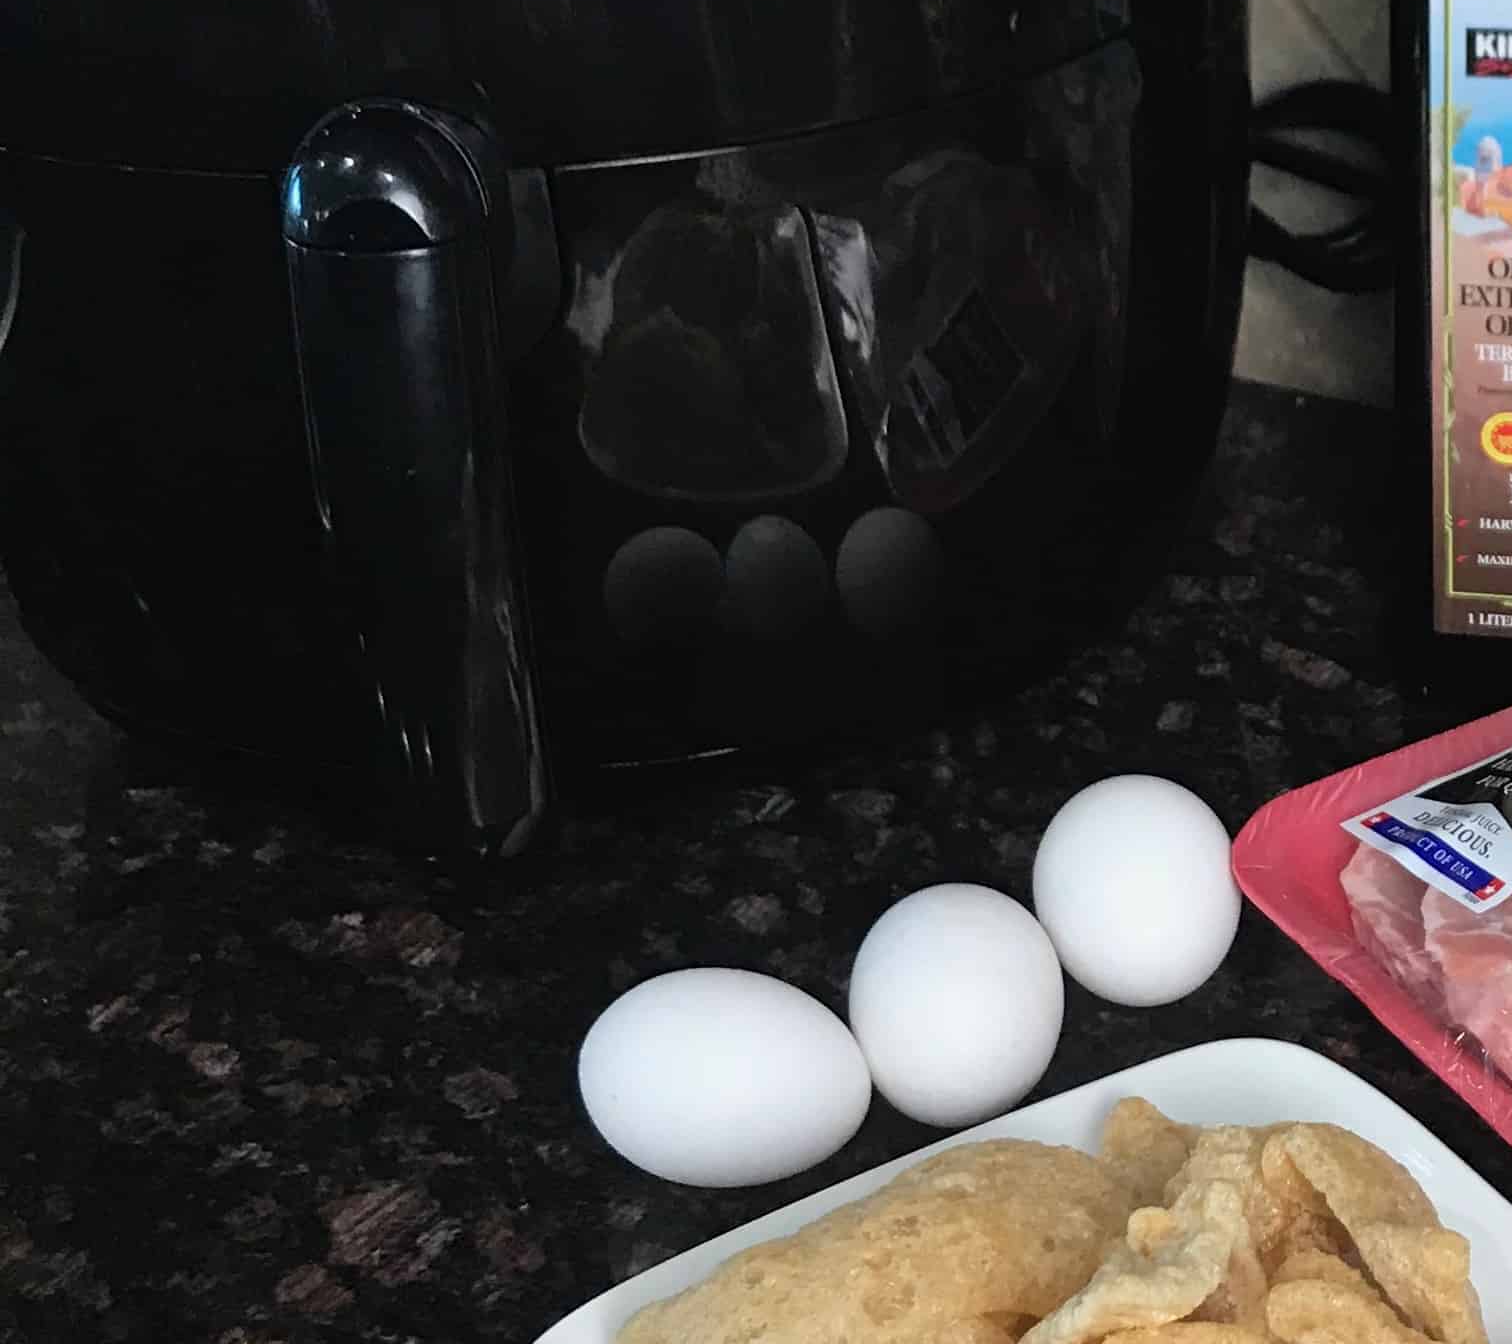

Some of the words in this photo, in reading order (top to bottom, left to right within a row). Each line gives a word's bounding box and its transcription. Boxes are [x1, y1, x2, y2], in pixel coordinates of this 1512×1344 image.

[1467, 612, 1474, 625] 1
[1413, 811, 1495, 859] DELICIOUS.
[1433, 848, 1452, 865] OF
[1450, 859, 1475, 881] USA
